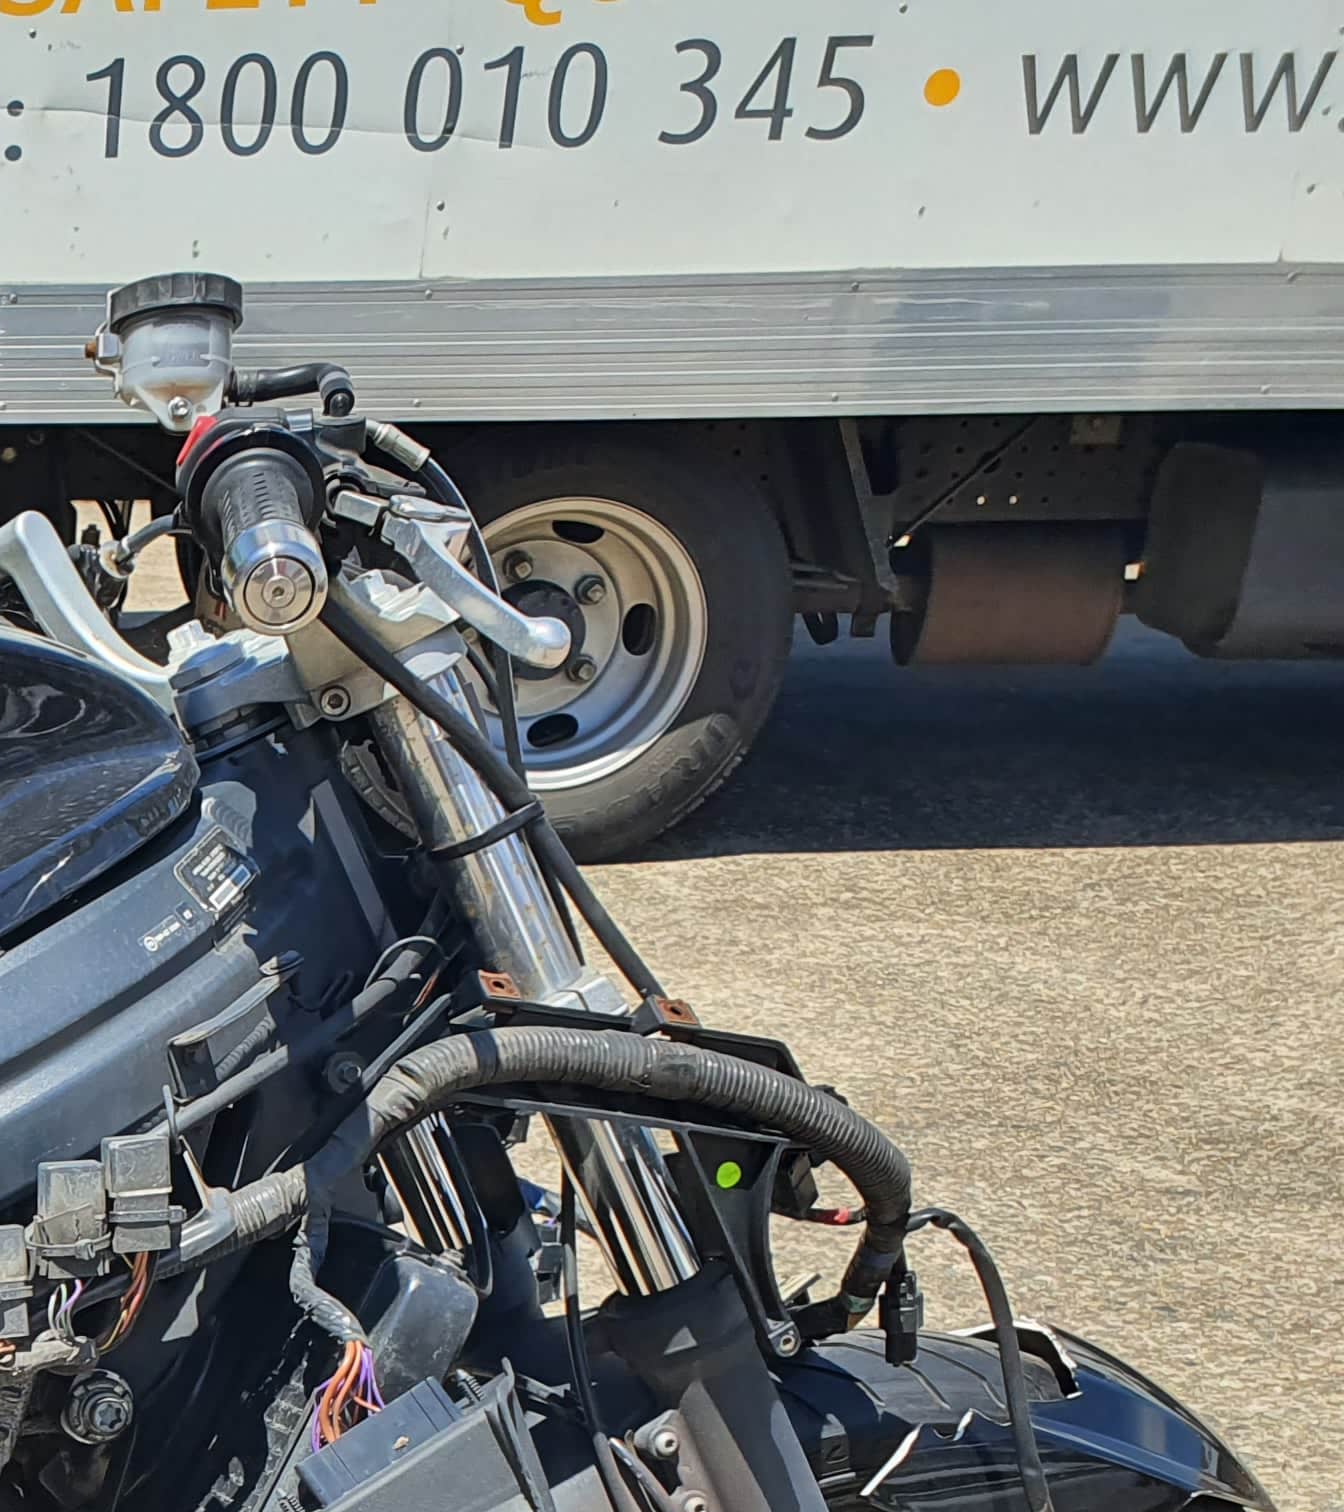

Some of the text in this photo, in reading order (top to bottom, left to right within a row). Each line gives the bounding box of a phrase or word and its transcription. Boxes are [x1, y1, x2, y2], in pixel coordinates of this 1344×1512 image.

[85, 49, 351, 160] 1800
[402, 42, 608, 154] 010
[657, 35, 874, 145] 345
